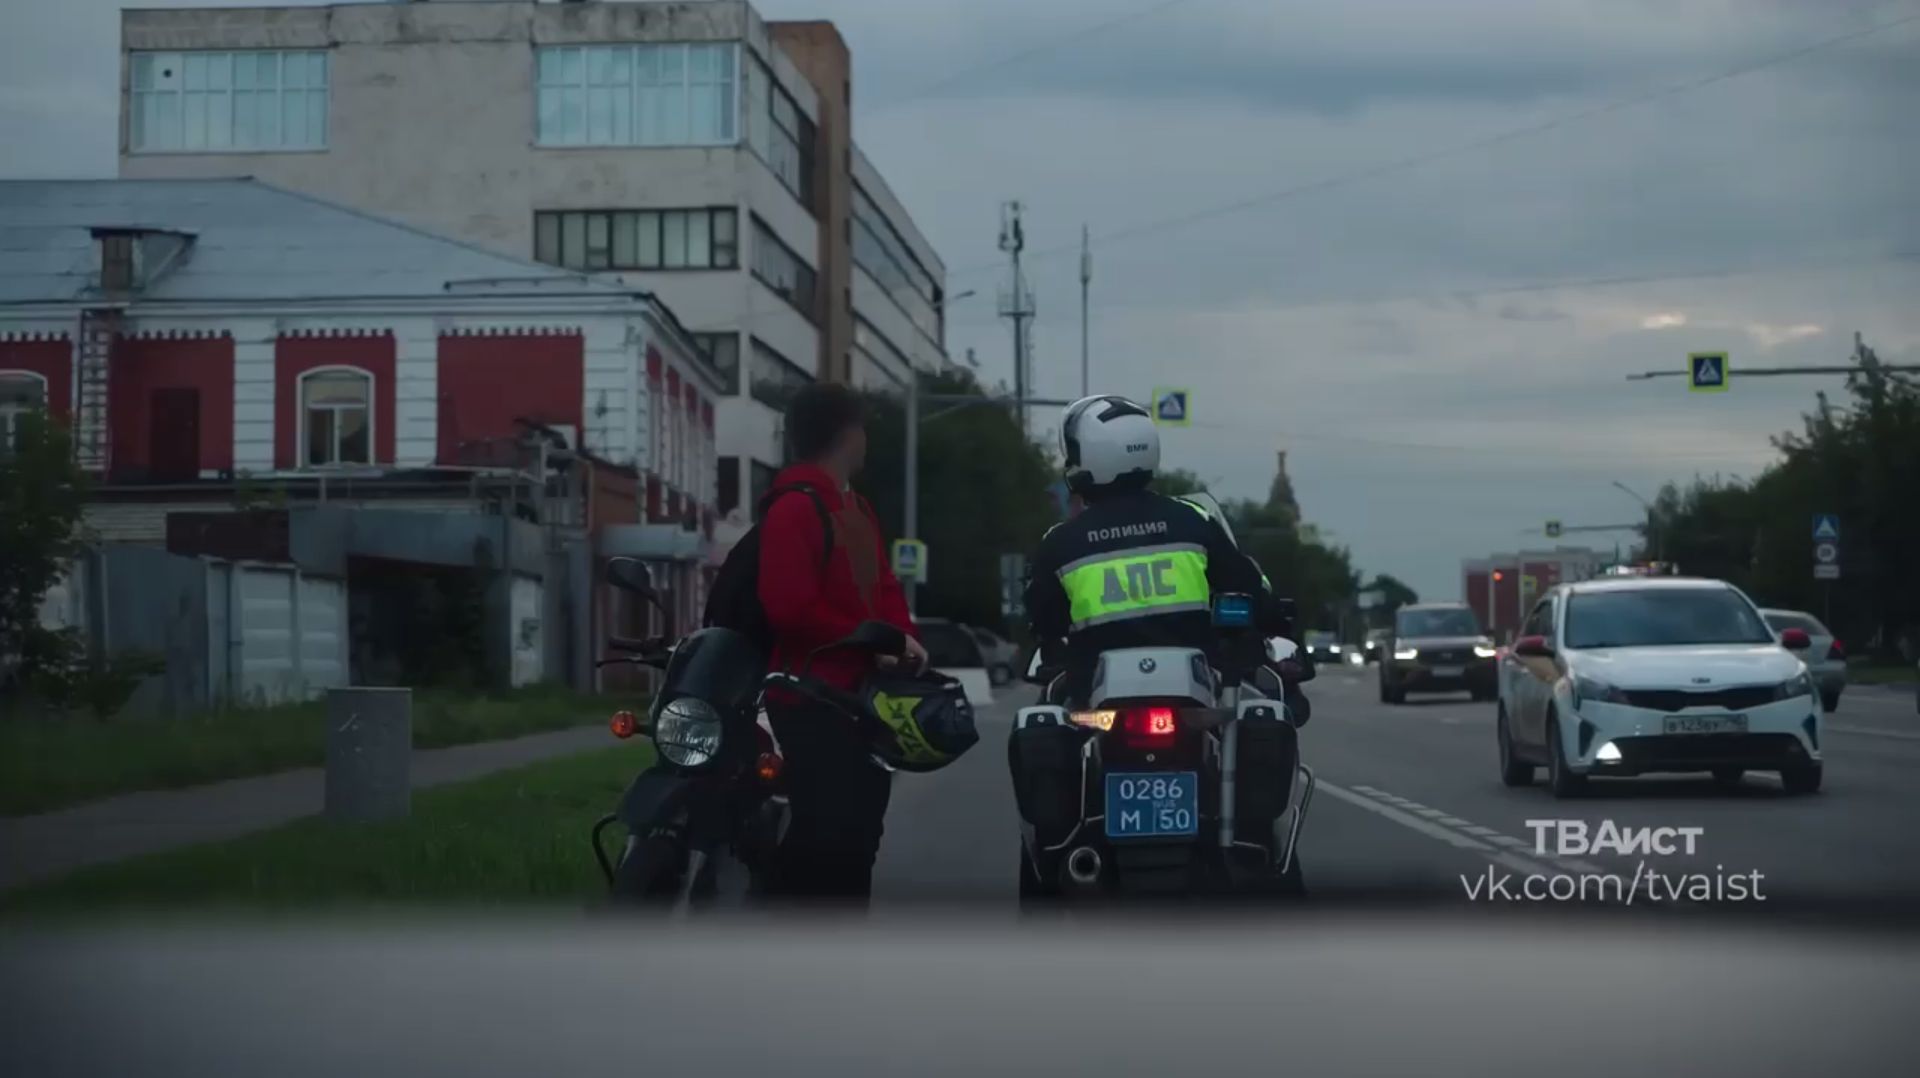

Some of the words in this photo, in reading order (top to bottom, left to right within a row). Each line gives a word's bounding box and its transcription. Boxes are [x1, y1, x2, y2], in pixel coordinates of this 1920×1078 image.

[1087, 521, 1168, 542] ПОЛИЦИЯ
[1101, 559, 1177, 605] ДПС
[1119, 779, 1183, 800] 0286
[1160, 808, 1190, 829] 50
